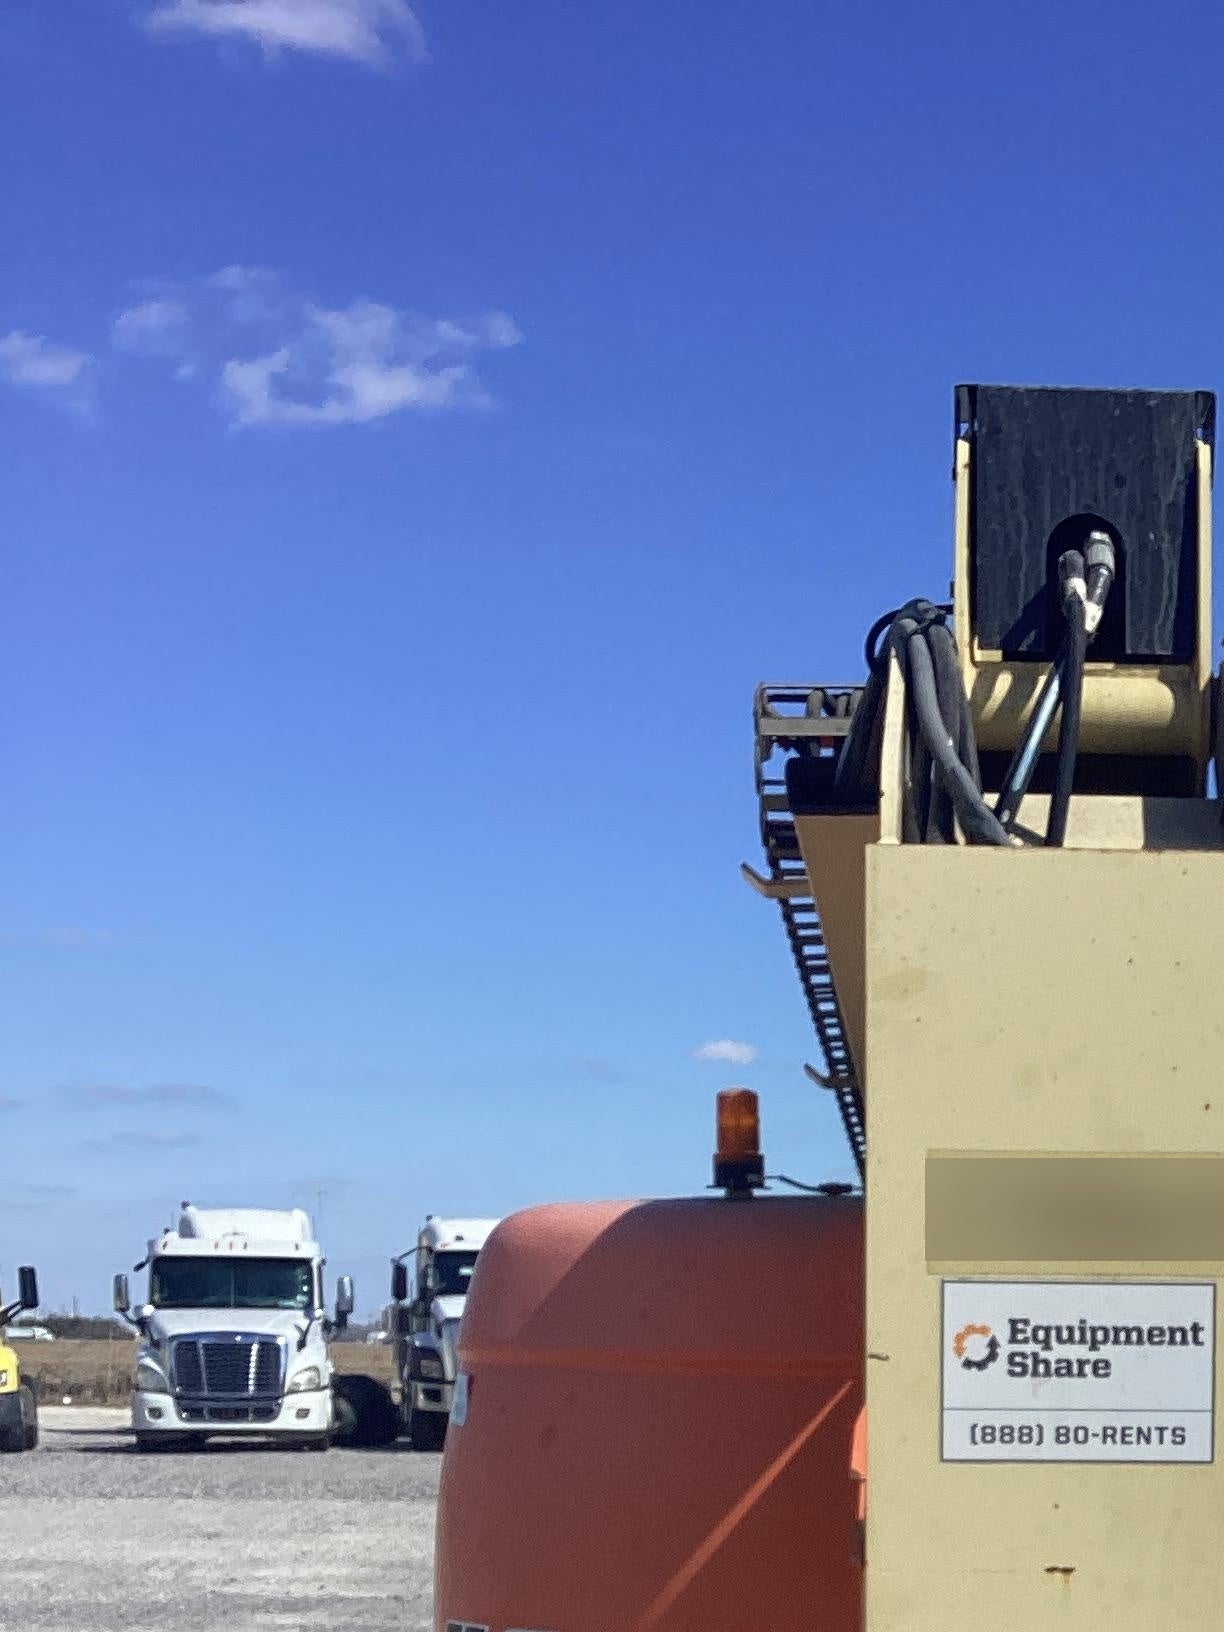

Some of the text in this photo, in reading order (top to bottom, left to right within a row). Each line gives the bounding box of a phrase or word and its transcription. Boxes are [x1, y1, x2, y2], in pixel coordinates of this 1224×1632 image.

[1007, 1318, 1205, 1351] Equipment
[1006, 1351, 1112, 1379] Share
[969, 1423, 1187, 1447] (888) 80-RENTS
